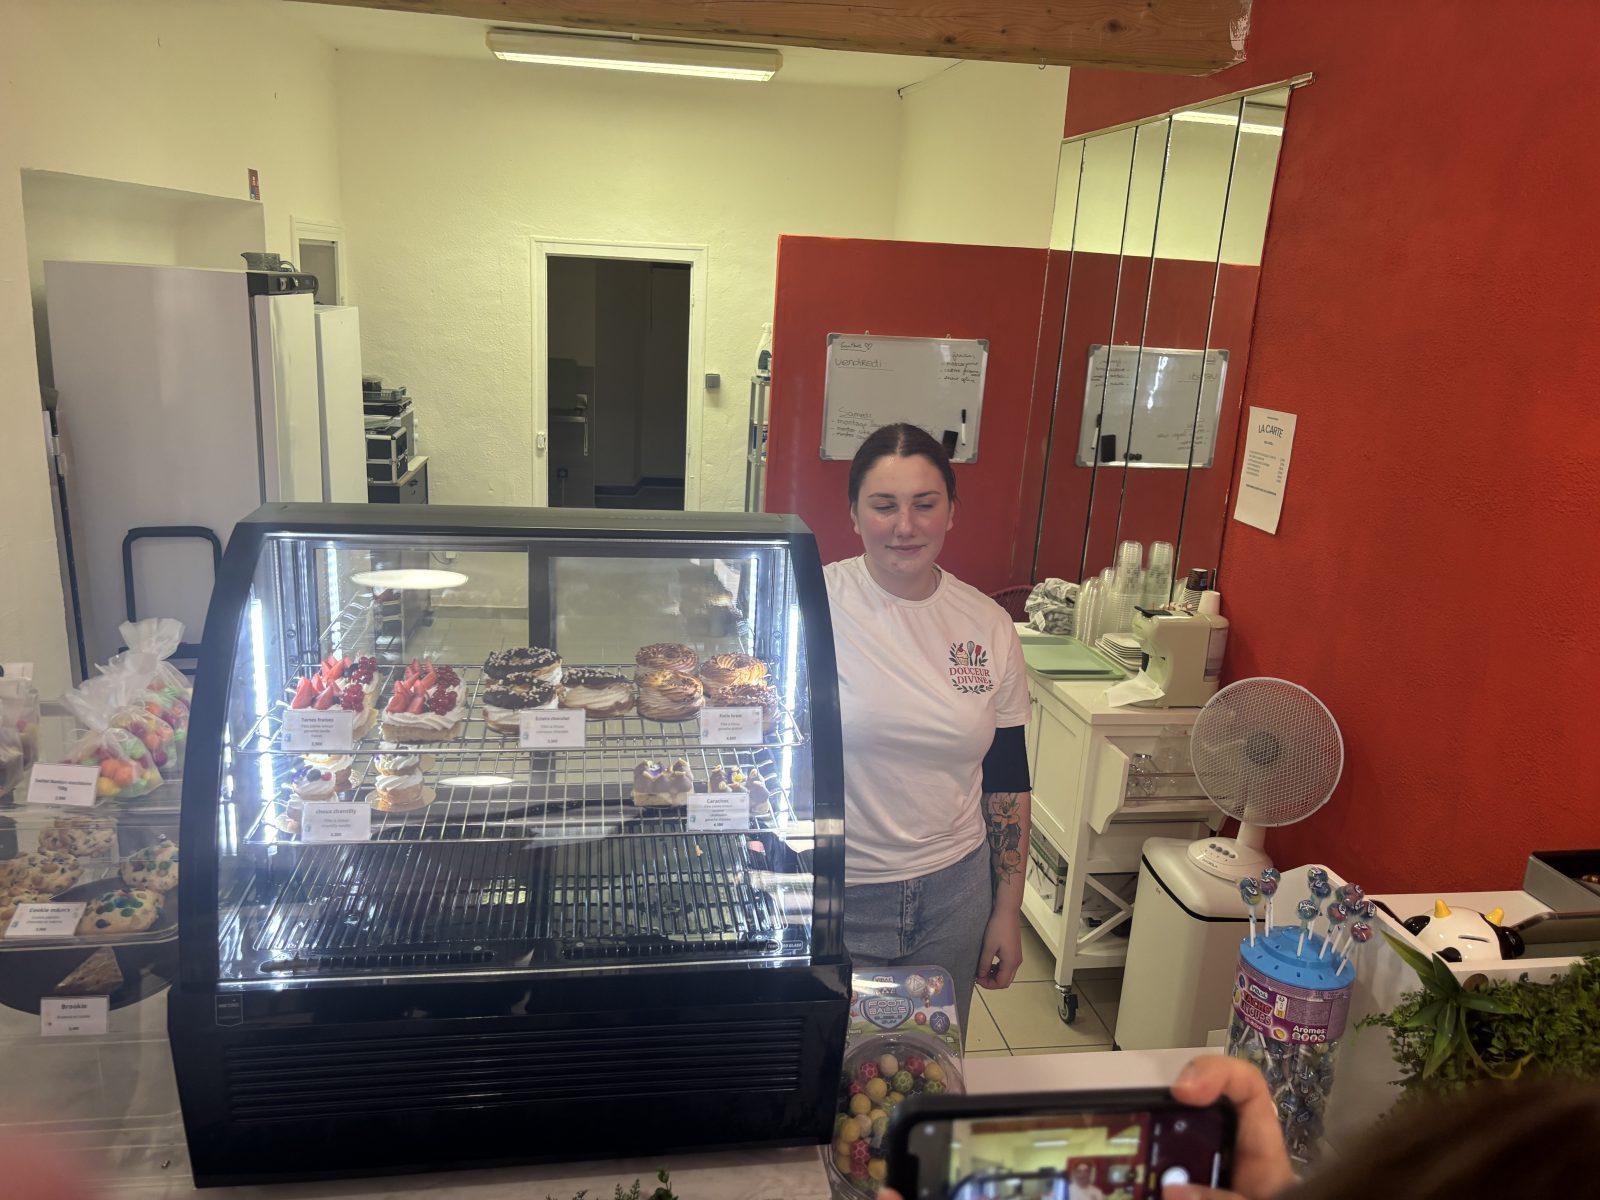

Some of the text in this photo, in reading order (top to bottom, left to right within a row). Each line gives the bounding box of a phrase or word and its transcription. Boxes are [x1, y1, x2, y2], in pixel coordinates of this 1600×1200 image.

[1258, 424, 1284, 439] LA CARTE
[948, 667, 991, 677] DOUCEUR
[956, 675, 989, 685] DIVINE
[868, 999, 905, 1008] FOOT
[868, 1006, 907, 1015] BALLS
